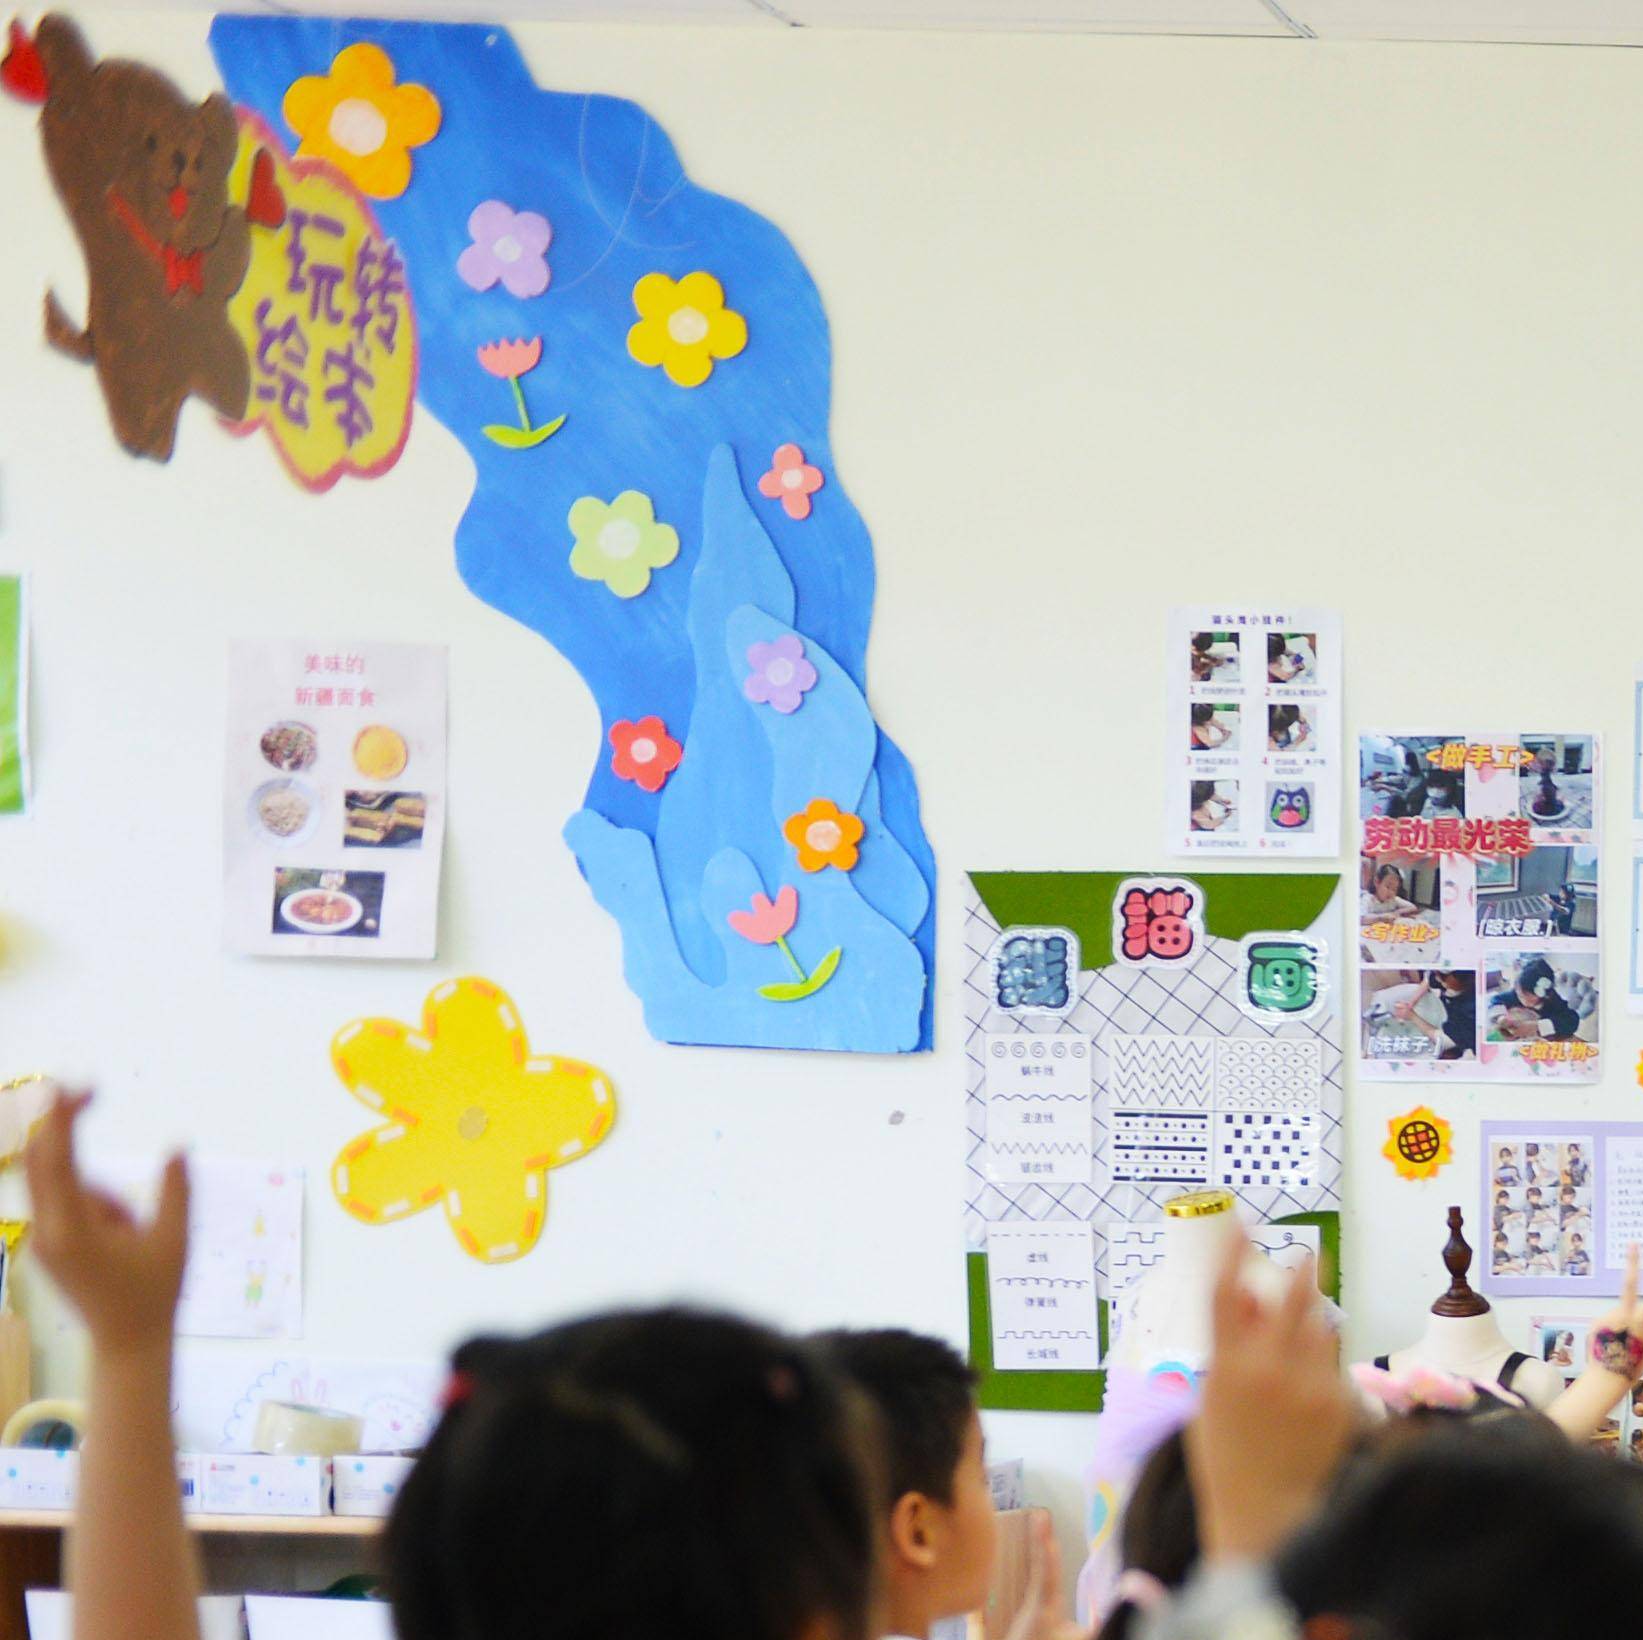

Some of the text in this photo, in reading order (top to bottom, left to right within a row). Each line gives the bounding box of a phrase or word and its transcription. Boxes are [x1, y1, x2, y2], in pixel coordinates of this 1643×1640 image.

[284, 208, 406, 357] 玩转
[253, 298, 378, 446] 绘本
[304, 653, 365, 675] 美味的
[1364, 817, 1535, 856] 劳动最光荣
